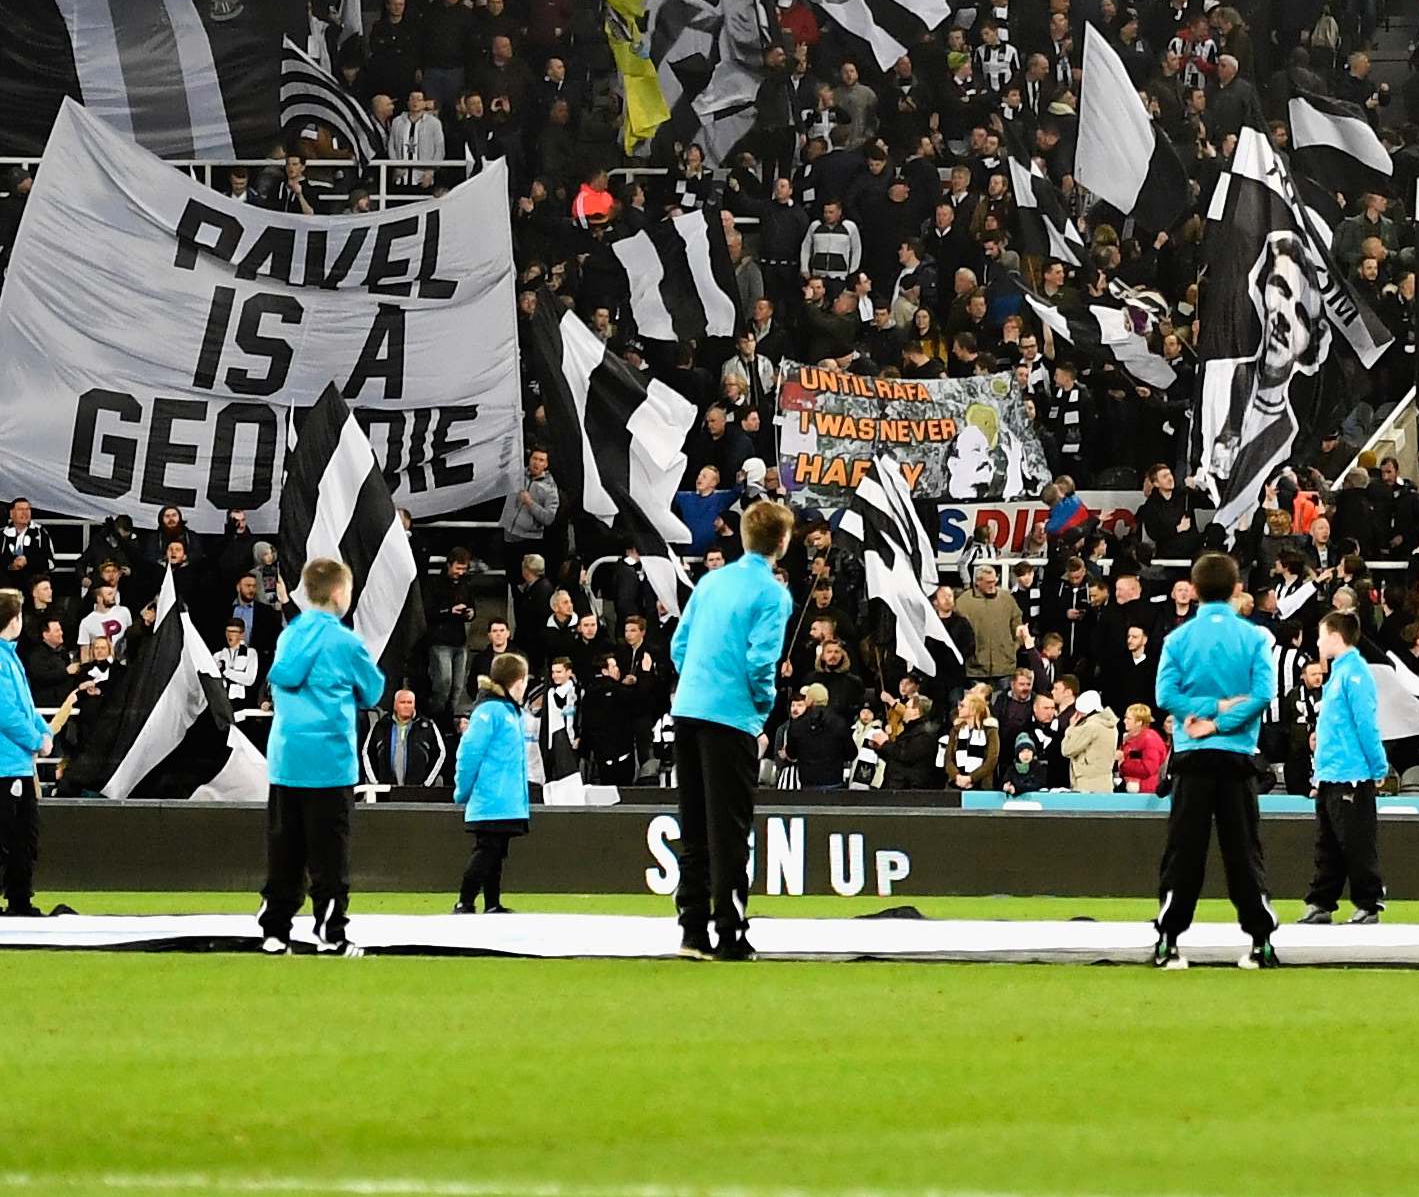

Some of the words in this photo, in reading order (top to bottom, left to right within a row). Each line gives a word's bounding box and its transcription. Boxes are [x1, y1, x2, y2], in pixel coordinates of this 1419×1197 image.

[173, 198, 459, 300] PAVEL
[193, 286, 305, 397] IS
[343, 302, 407, 400] A
[800, 365, 874, 398] UNTIL
[874, 378, 932, 402] RAFA
[68, 387, 478, 511] GEODIE
[800, 410, 809, 433] I
[815, 411, 876, 441] WAS
[880, 417, 957, 443] NEVER
[794, 452, 927, 491] HAPY
[645, 815, 805, 895] SN
